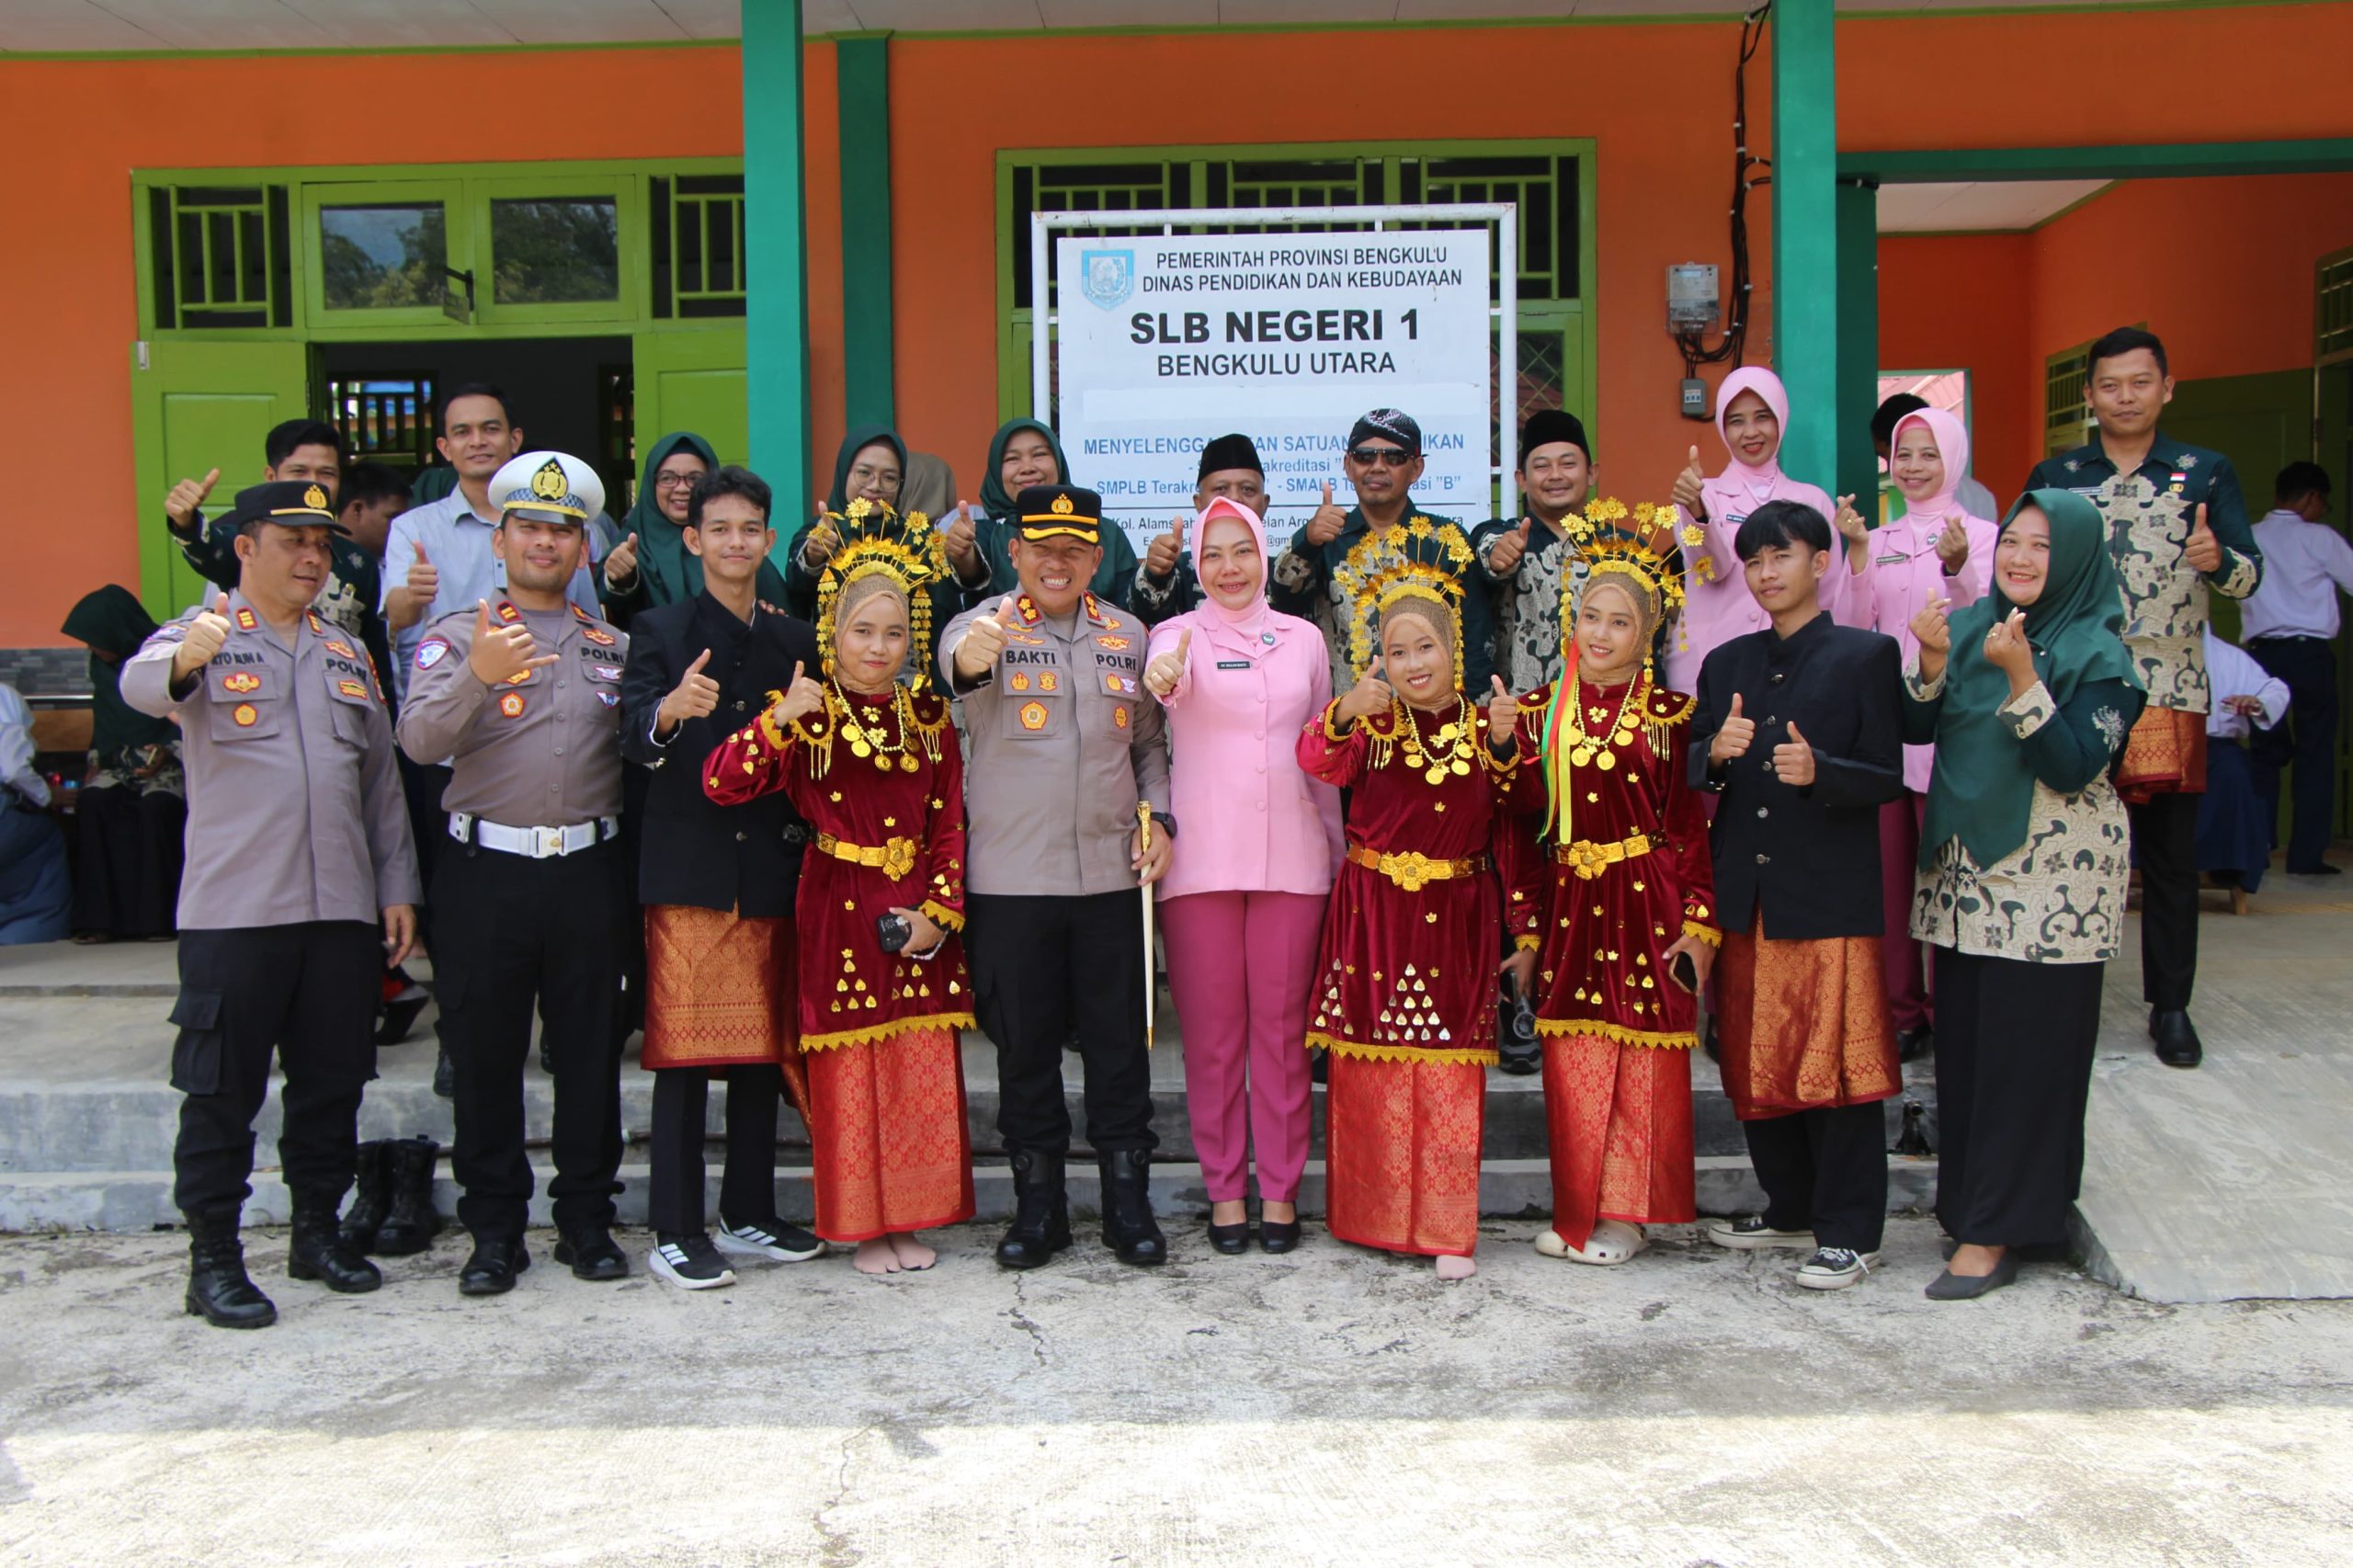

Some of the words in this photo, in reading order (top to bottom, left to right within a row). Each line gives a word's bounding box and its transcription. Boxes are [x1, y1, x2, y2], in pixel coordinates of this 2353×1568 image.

[1156, 250, 1264, 269] PEMERINTAH
[1269, 248, 1348, 267] PROVINSI
[1353, 246, 1447, 266] BENGKULU
[1142, 274, 1194, 292] DINAS
[1199, 272, 1302, 291] PENDIDIKAN
[1306, 271, 1342, 290] DAN
[1347, 268, 1462, 288] KEBUDAYAAN
[1130, 312, 1211, 345] SLB
[1225, 309, 1383, 343] NEGERI
[1400, 308, 1418, 340] 1
[1157, 352, 1302, 377] BENGKULU
[1310, 351, 1396, 375] UTARA
[1097, 480, 1147, 495] SMPLB
[1138, 517, 1195, 530] Alamsah
[580, 647, 625, 664] POLRI
[1006, 650, 1056, 665] BAKTI
[1096, 653, 1137, 671] POLRI
[325, 657, 368, 683] POLRI
